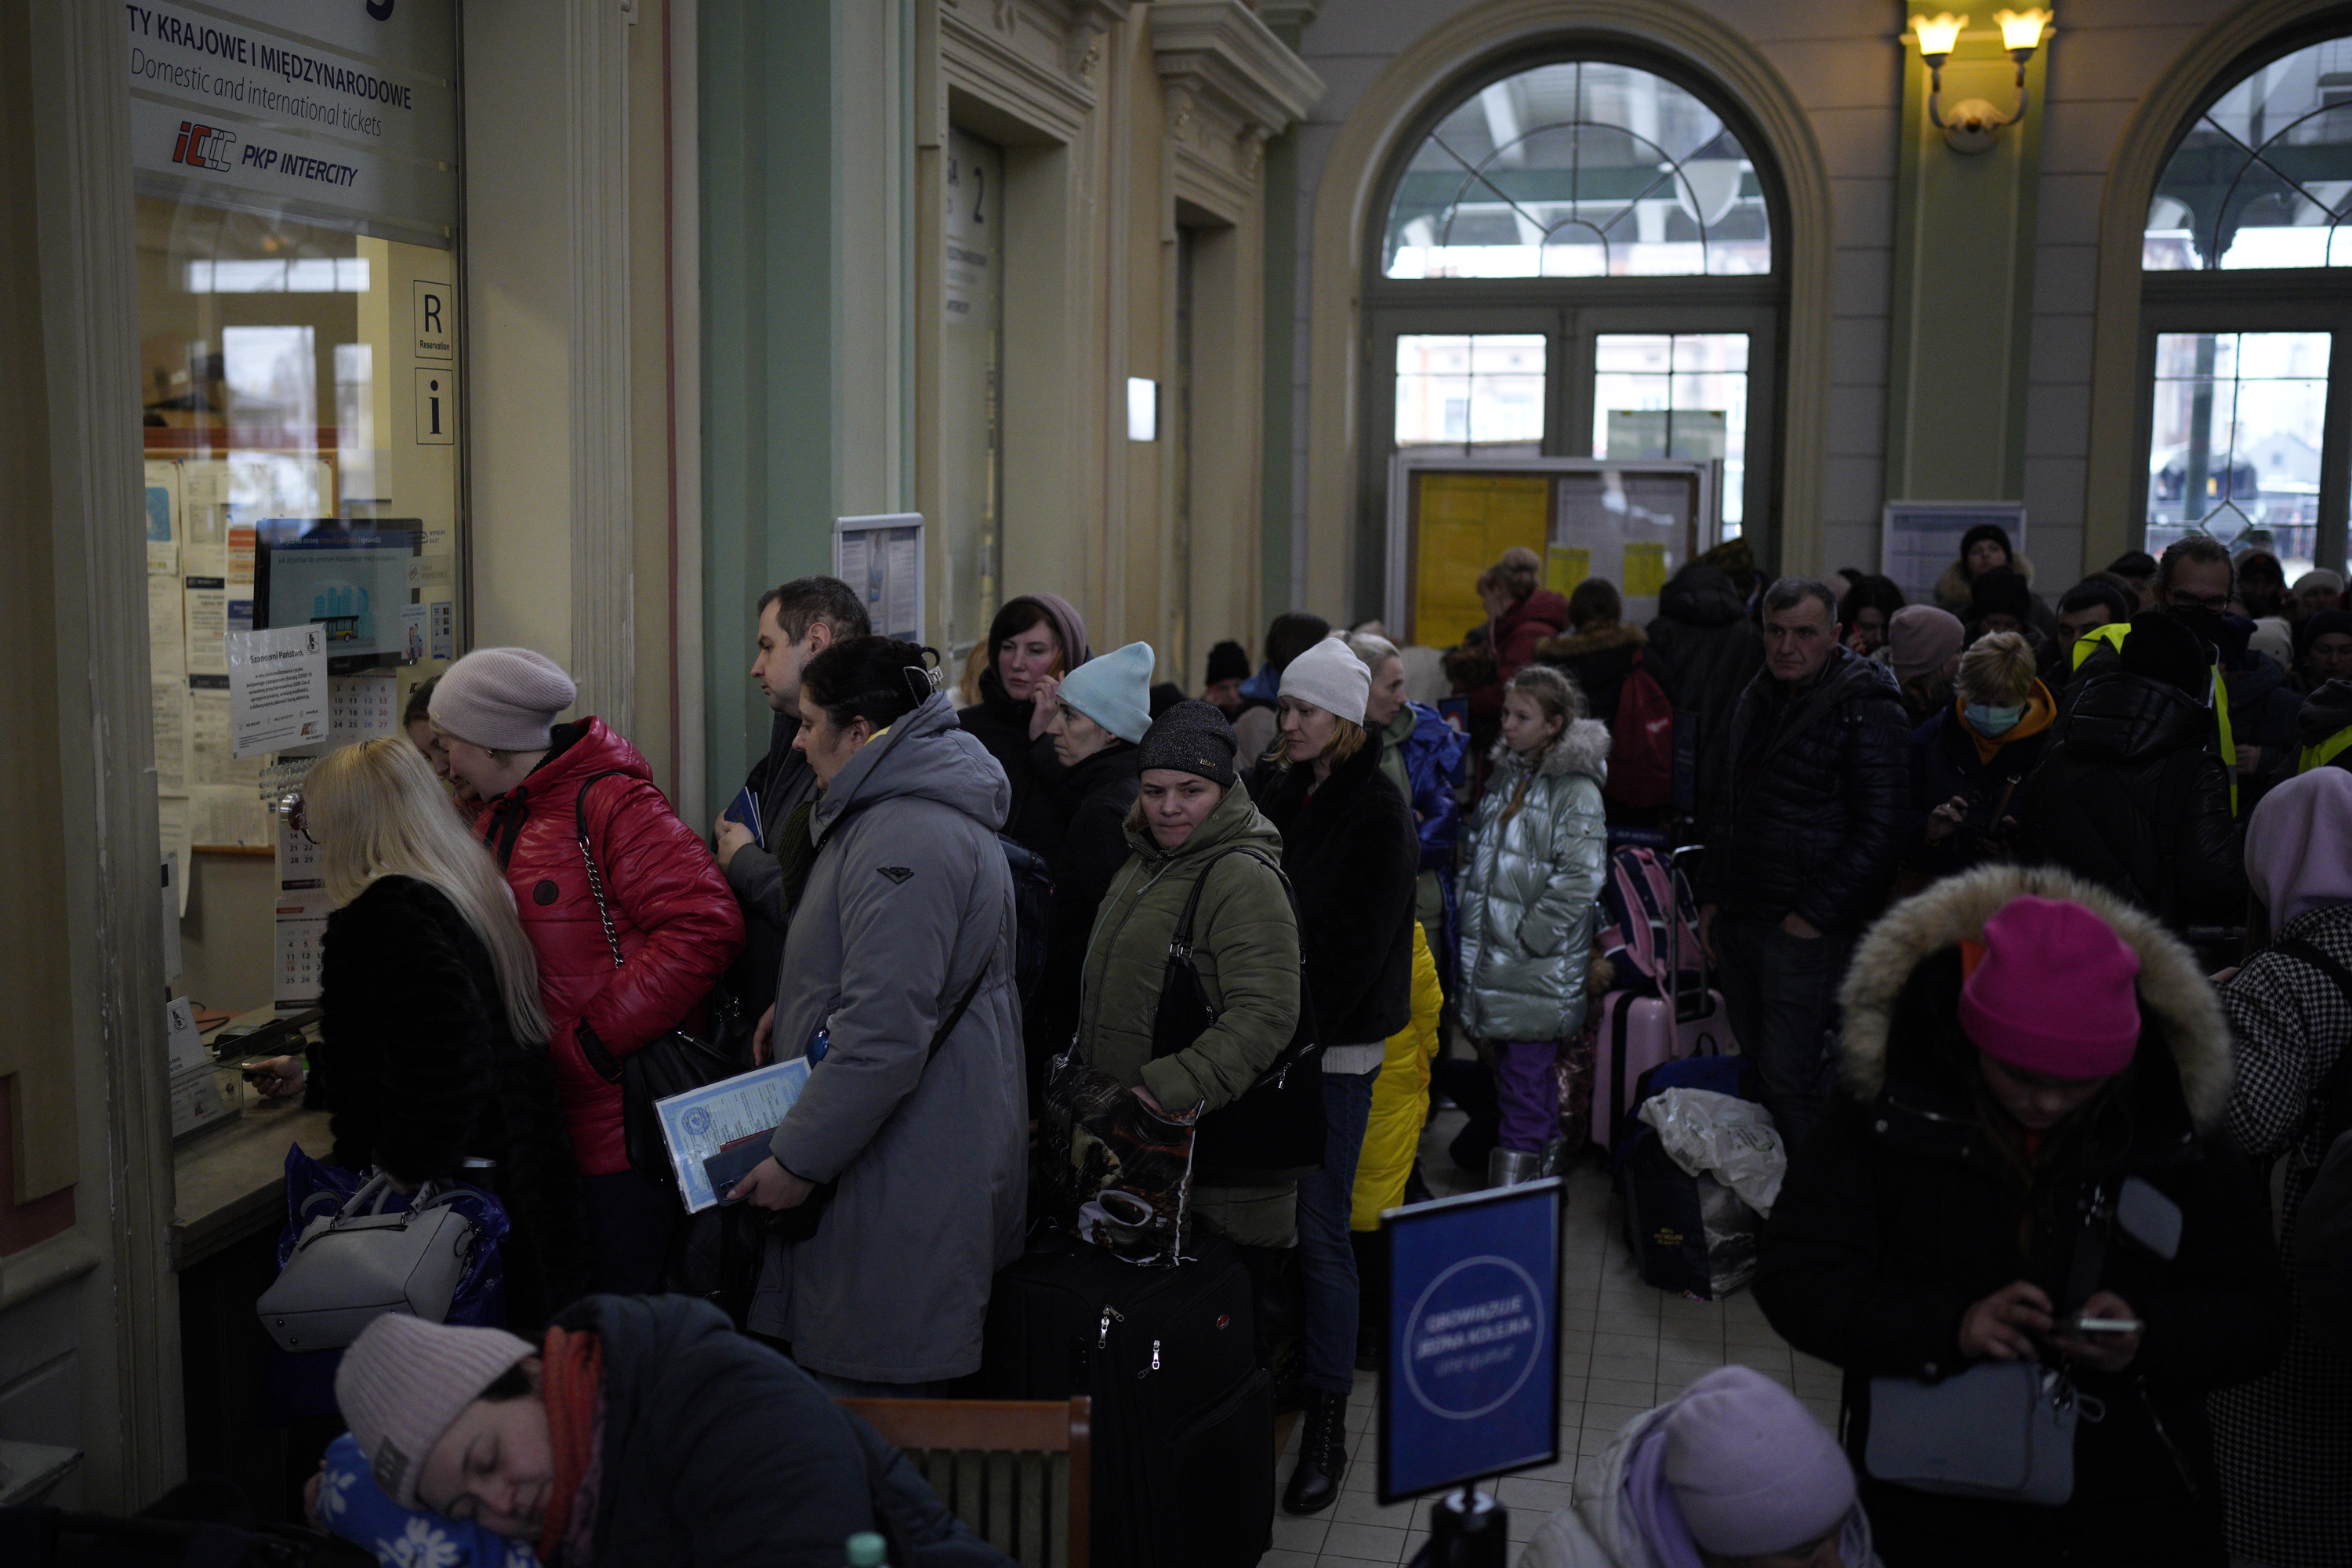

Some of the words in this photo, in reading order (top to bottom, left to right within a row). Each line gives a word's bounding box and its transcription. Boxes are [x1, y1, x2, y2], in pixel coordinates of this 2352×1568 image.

[158, 13, 247, 64] KRAJOWE
[252, 42, 256, 67] I
[261, 46, 412, 110] MIĘDZYNARODOWE
[132, 48, 210, 93] Domestic
[214, 77, 244, 101] and
[249, 81, 339, 125] international
[343, 107, 382, 136] tickets
[241, 144, 278, 169] PKP
[280, 153, 358, 187] INTERCITY
[424, 294, 442, 334] R
[419, 339, 450, 352] Reservation
[250, 651, 278, 664] Szanowni
